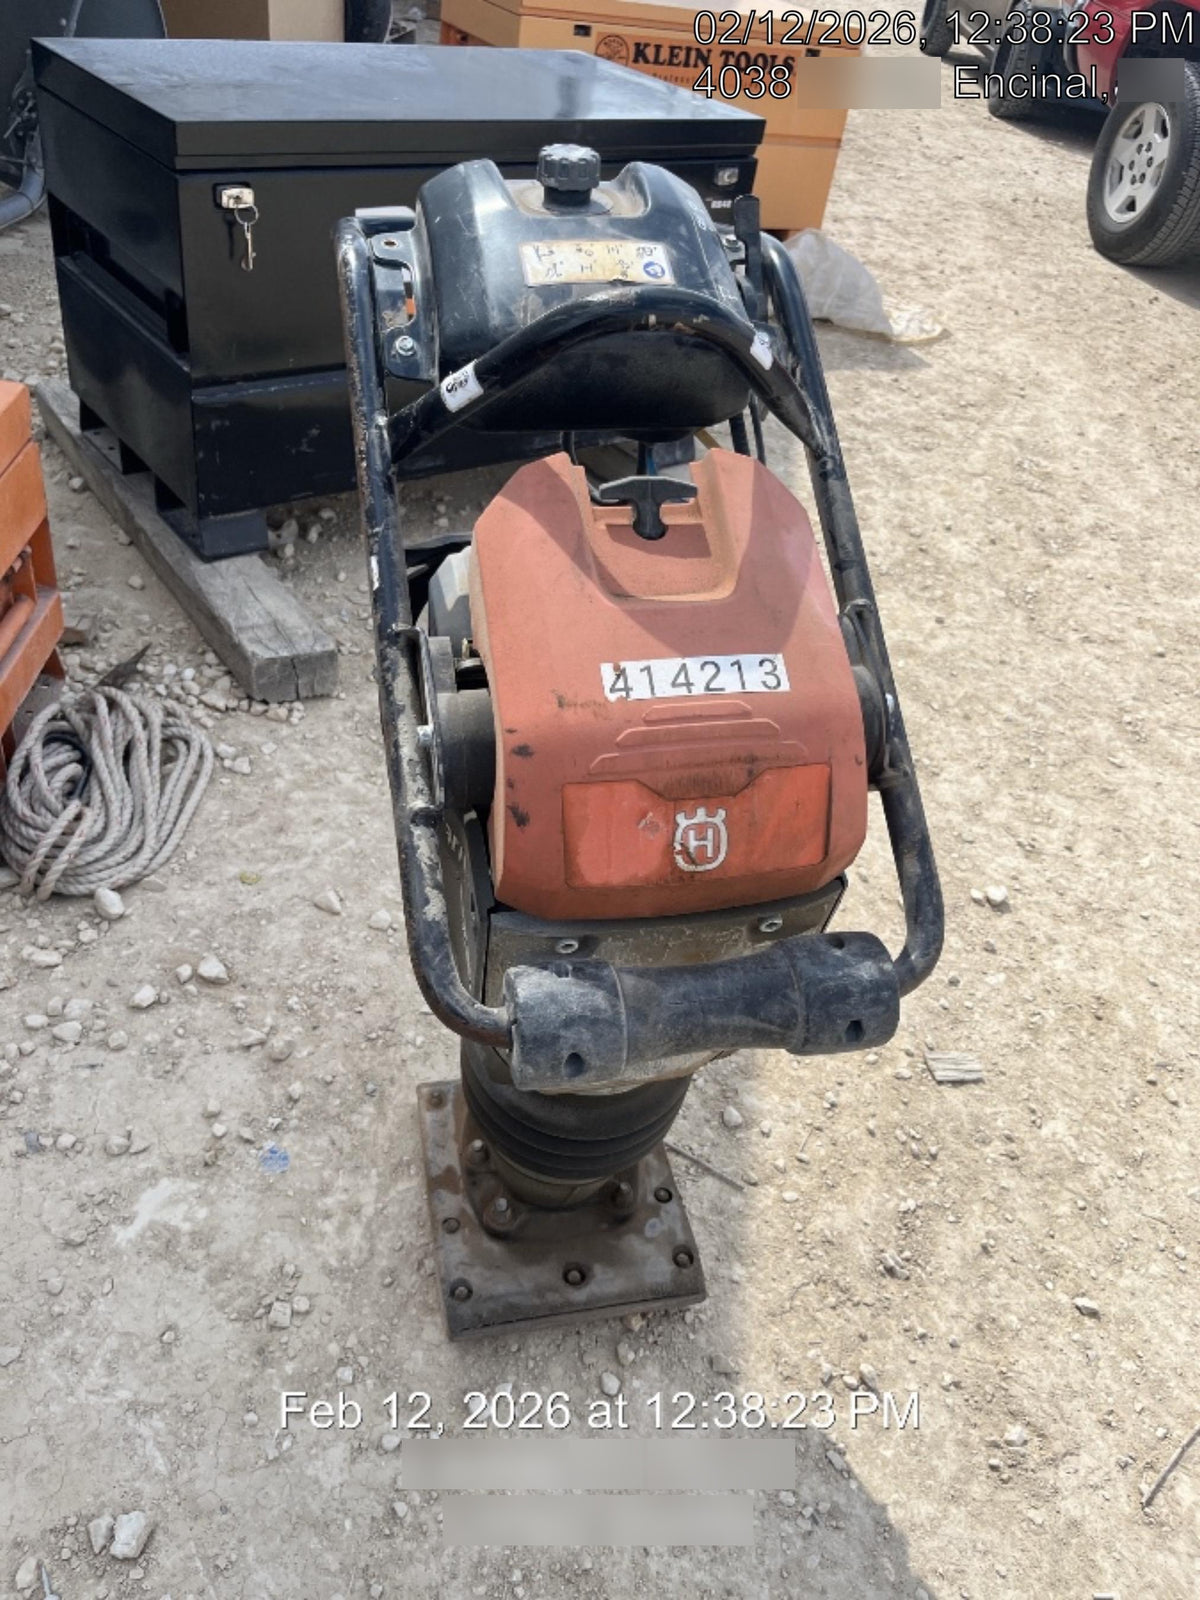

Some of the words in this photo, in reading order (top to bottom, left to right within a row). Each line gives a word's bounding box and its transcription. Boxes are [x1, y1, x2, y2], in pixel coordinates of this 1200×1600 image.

[632, 41, 713, 68] KLEIN
[719, 50, 796, 76] TOOLS
[609, 658, 782, 699] 414213
